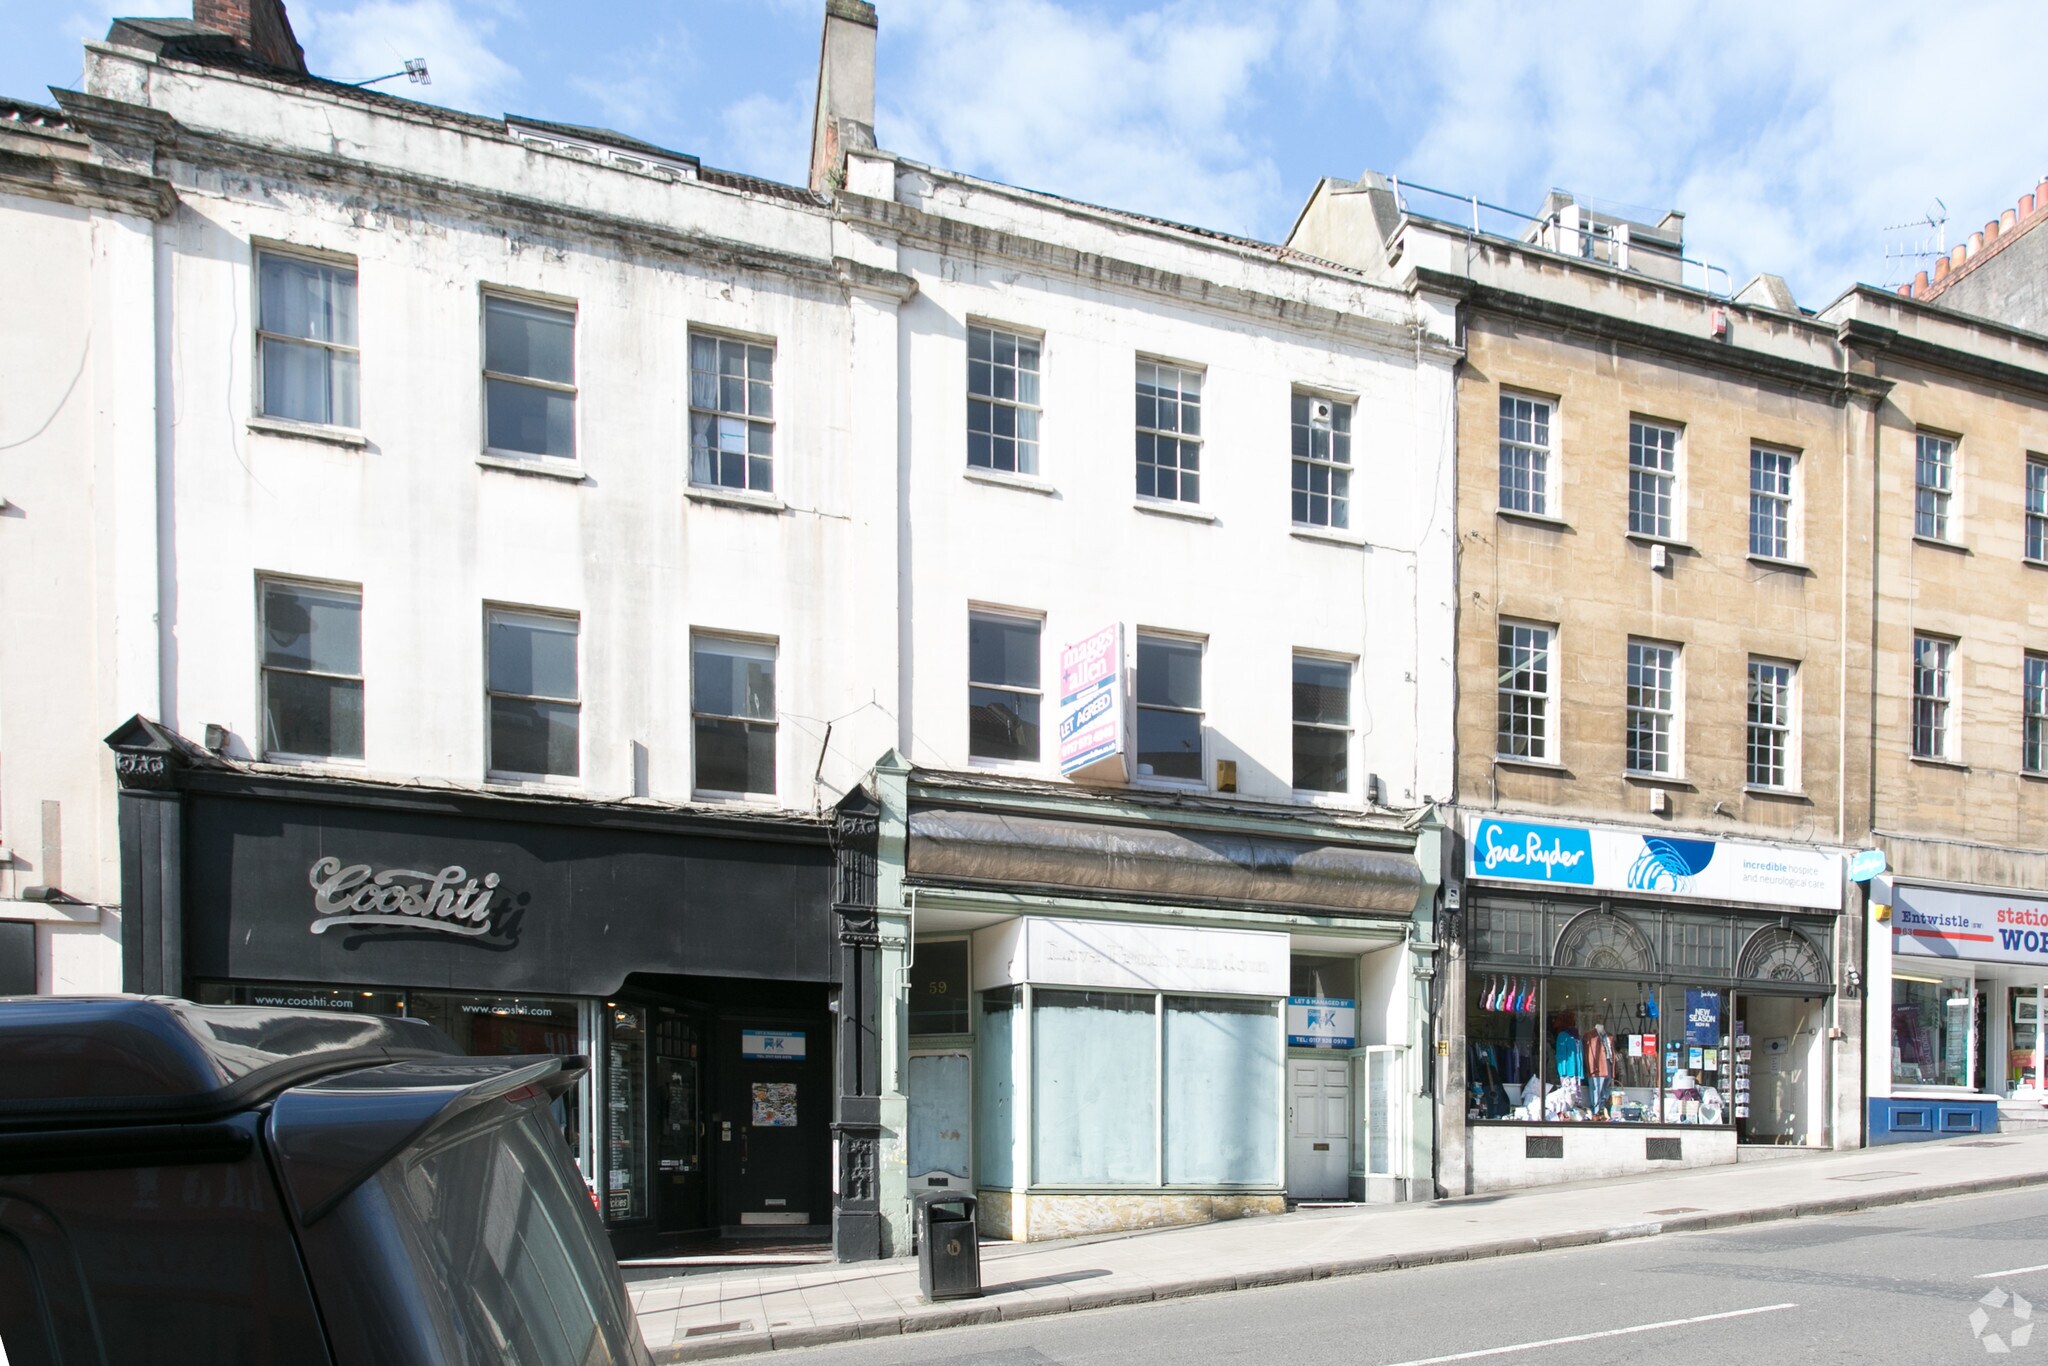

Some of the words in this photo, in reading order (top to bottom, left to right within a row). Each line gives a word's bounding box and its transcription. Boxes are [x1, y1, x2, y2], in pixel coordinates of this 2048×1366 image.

[1063, 627, 1114, 669] maggs
[1060, 716, 1075, 739] LET
[1076, 693, 1111, 727] AGREED
[1485, 824, 1526, 869] Sue
[1525, 831, 1585, 879] Ryder
[1743, 859, 1788, 873] incredible
[1788, 864, 1819, 876] hospice
[1742, 873, 1758, 883] and
[1759, 875, 1807, 889] neurological
[1808, 880, 1825, 889] care
[309, 856, 500, 923] Cooshti
[1901, 911, 1970, 928] Entwistle
[1997, 907, 2048, 927] statio
[1902, 927, 1913, 936] 63
[928, 981, 947, 994] 59
[1846, 985, 1857, 998] 61
[254, 994, 354, 1010] www.cooshti.com
[462, 1003, 553, 1018] www.cooshti.com
[1688, 1014, 1716, 1023] SEASON
[1694, 1008, 1711, 1017] NEW
